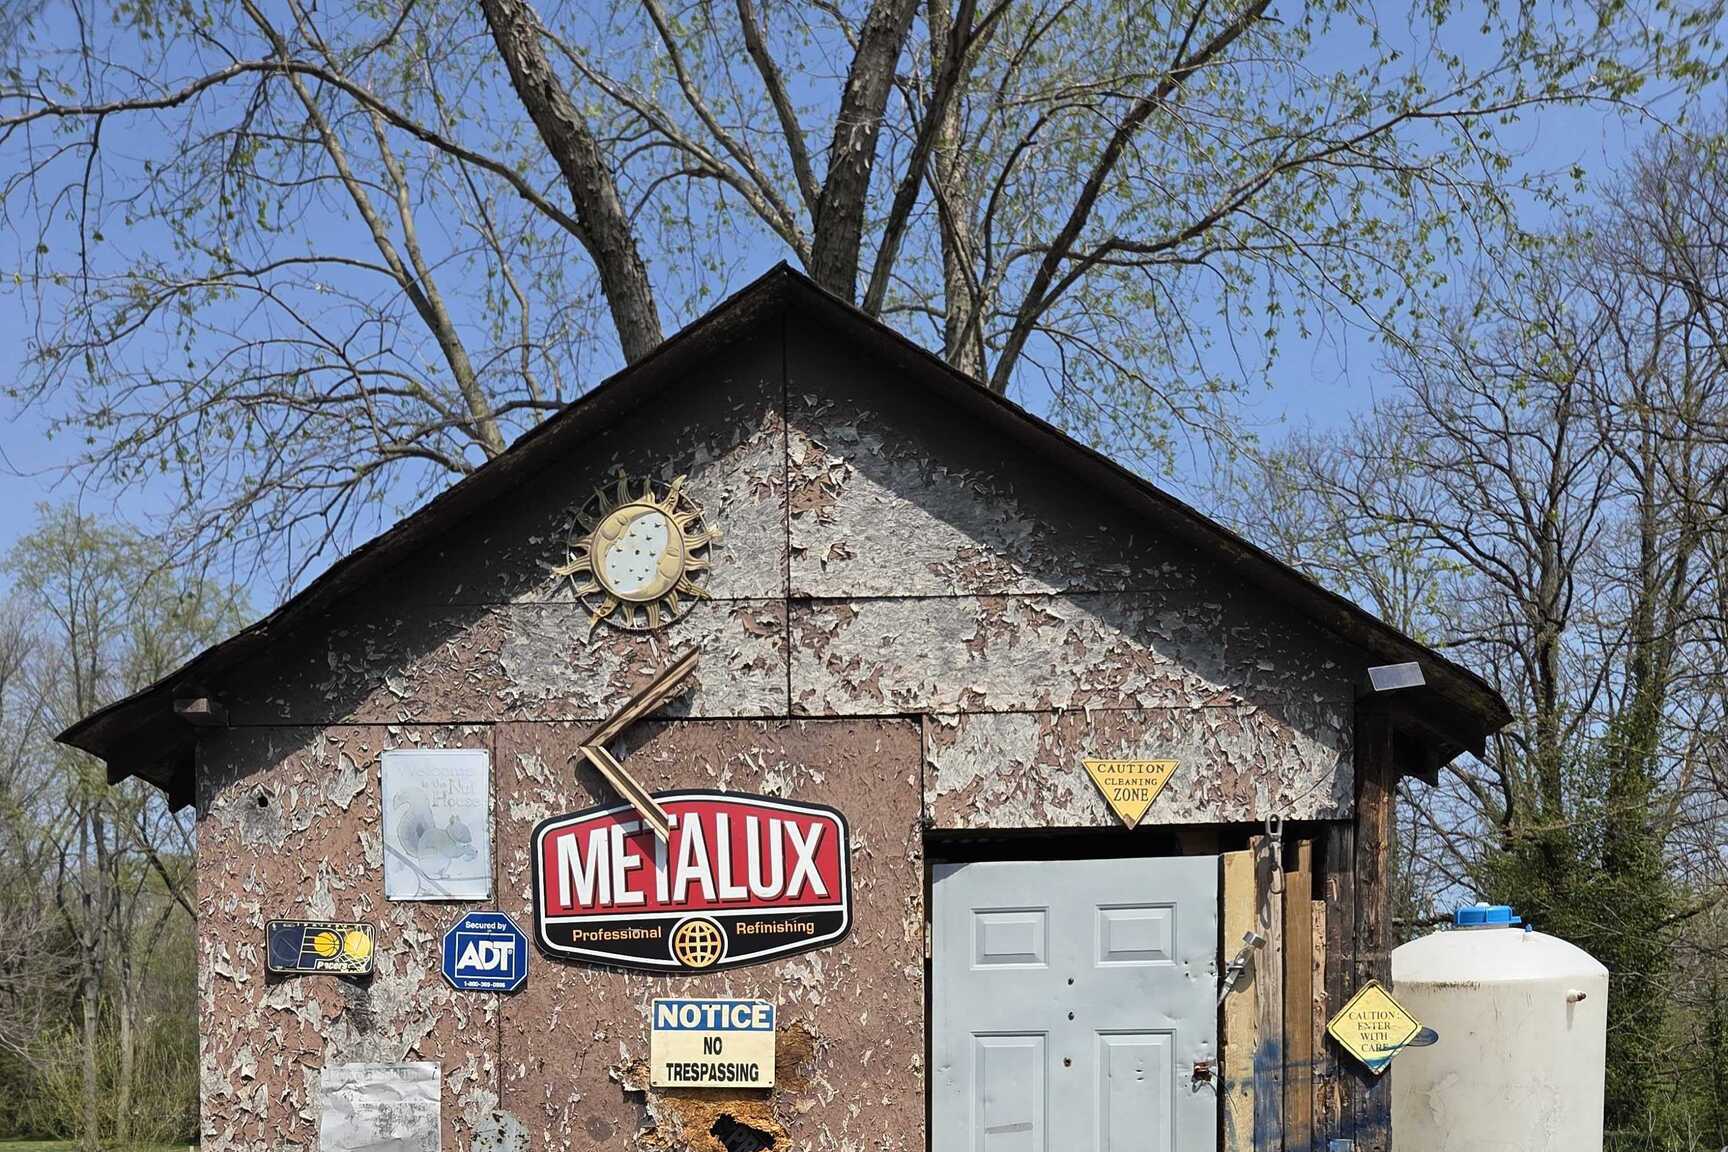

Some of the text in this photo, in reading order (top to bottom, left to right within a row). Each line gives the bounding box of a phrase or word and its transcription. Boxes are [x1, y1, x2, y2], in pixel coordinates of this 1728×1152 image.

[1097, 764, 1165, 774] CAUTION
[1104, 778, 1158, 786] CLEANING
[1114, 788, 1149, 802] ZONE
[556, 812, 829, 908] METALUX
[465, 921, 507, 931] Secured by
[572, 919, 815, 943] Professional Refinishing
[457, 940, 514, 971] ADT
[658, 1003, 770, 1029] NOTICE
[1358, 1022, 1391, 1030] ENTER
[1361, 1033, 1388, 1041] WITH
[703, 1036, 723, 1055] NO
[666, 1062, 760, 1082] TRESPASSING
